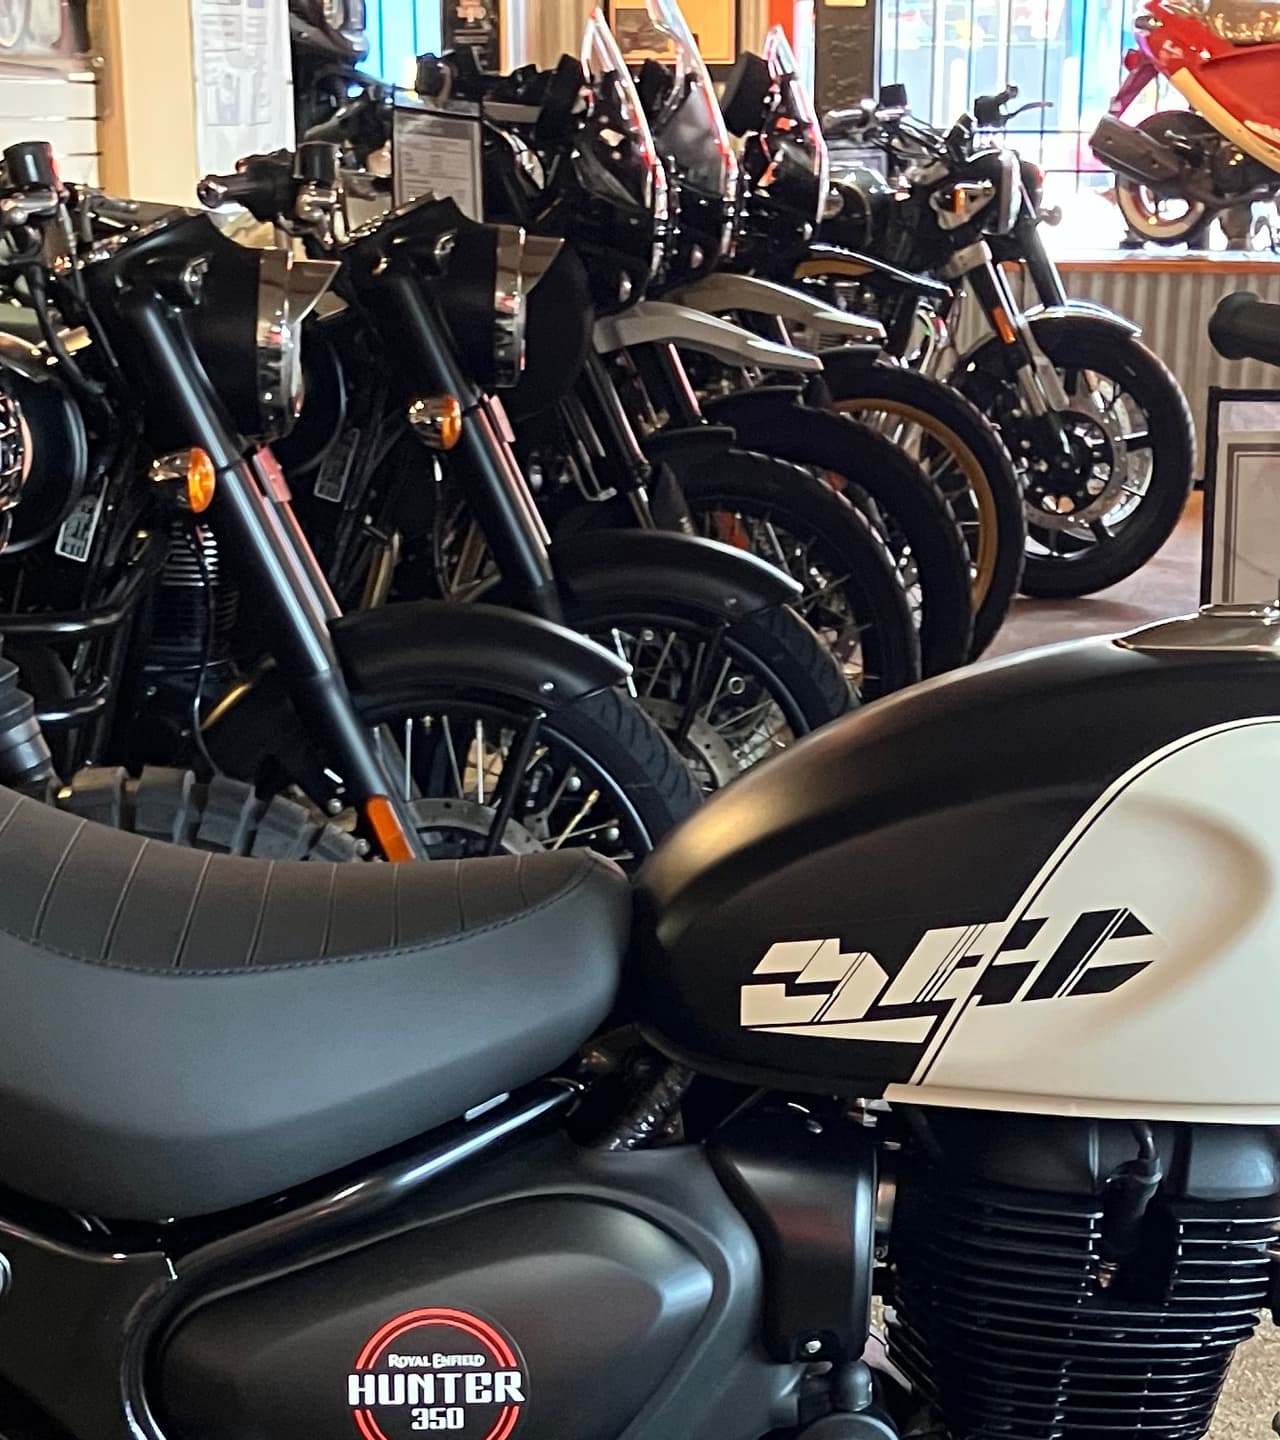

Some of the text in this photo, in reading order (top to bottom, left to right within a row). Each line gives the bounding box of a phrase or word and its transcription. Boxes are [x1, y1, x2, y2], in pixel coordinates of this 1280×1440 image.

[388, 1353, 485, 1369] ROYAL ENFIELD
[347, 1371, 526, 1405] HUNTER
[411, 1407, 464, 1430] 350
